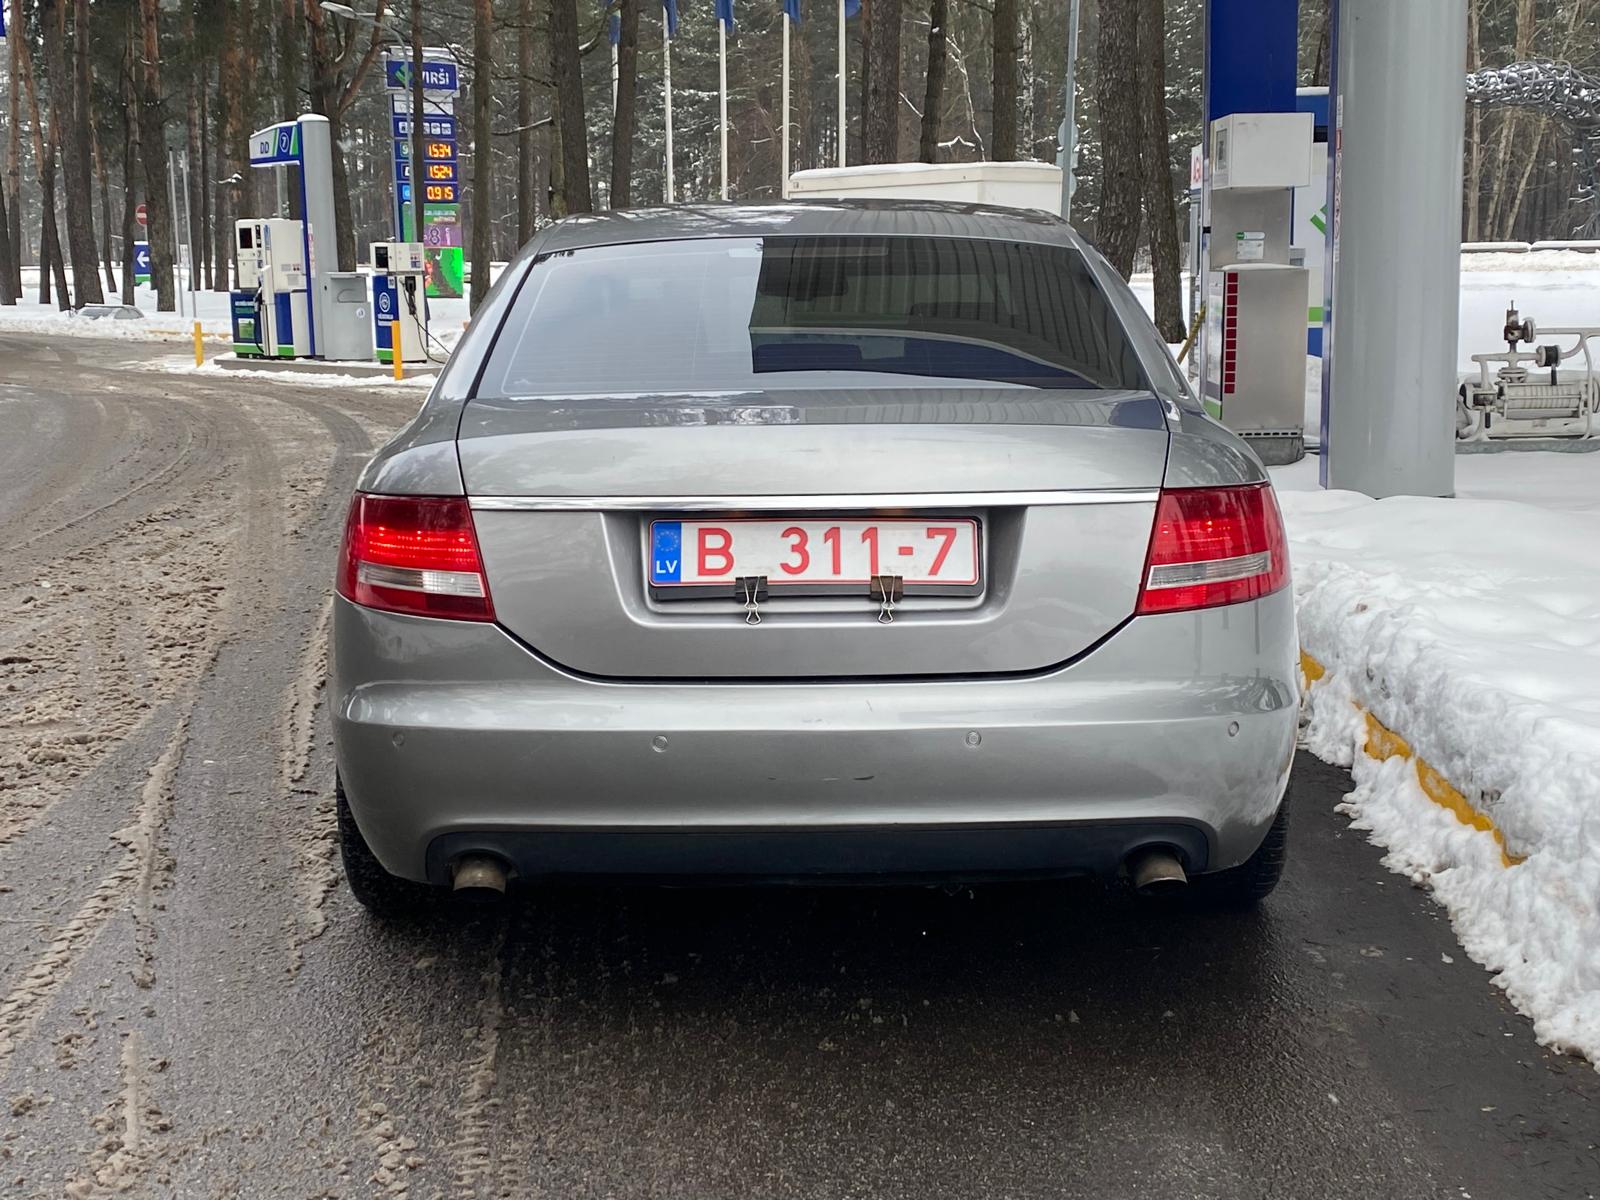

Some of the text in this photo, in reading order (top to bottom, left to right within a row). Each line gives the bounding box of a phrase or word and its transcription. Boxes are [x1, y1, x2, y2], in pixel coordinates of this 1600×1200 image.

[655, 560, 677, 574] LV
[697, 526, 958, 577] B 311-7
